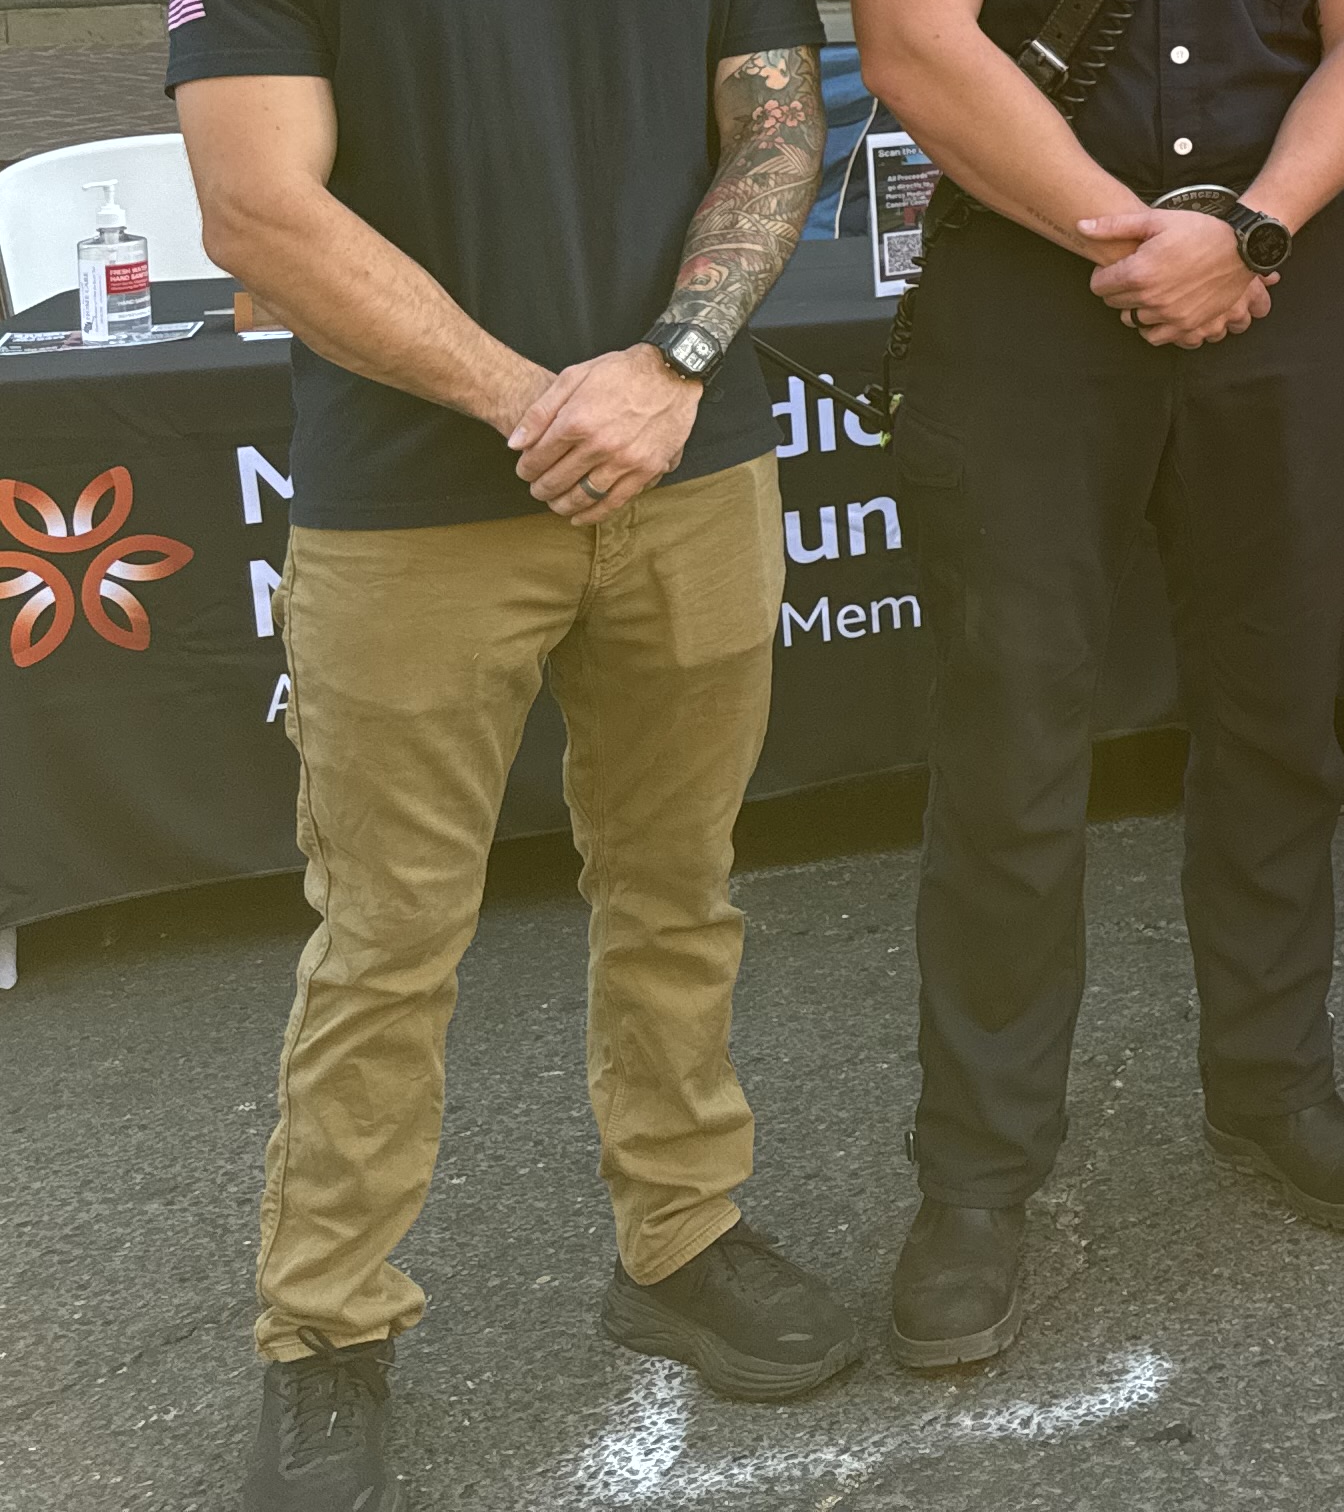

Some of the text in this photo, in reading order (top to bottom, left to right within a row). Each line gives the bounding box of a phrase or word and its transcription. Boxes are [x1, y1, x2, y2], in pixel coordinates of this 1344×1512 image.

[878, 147, 917, 158] Scan the
[109, 274, 131, 282] HAND
